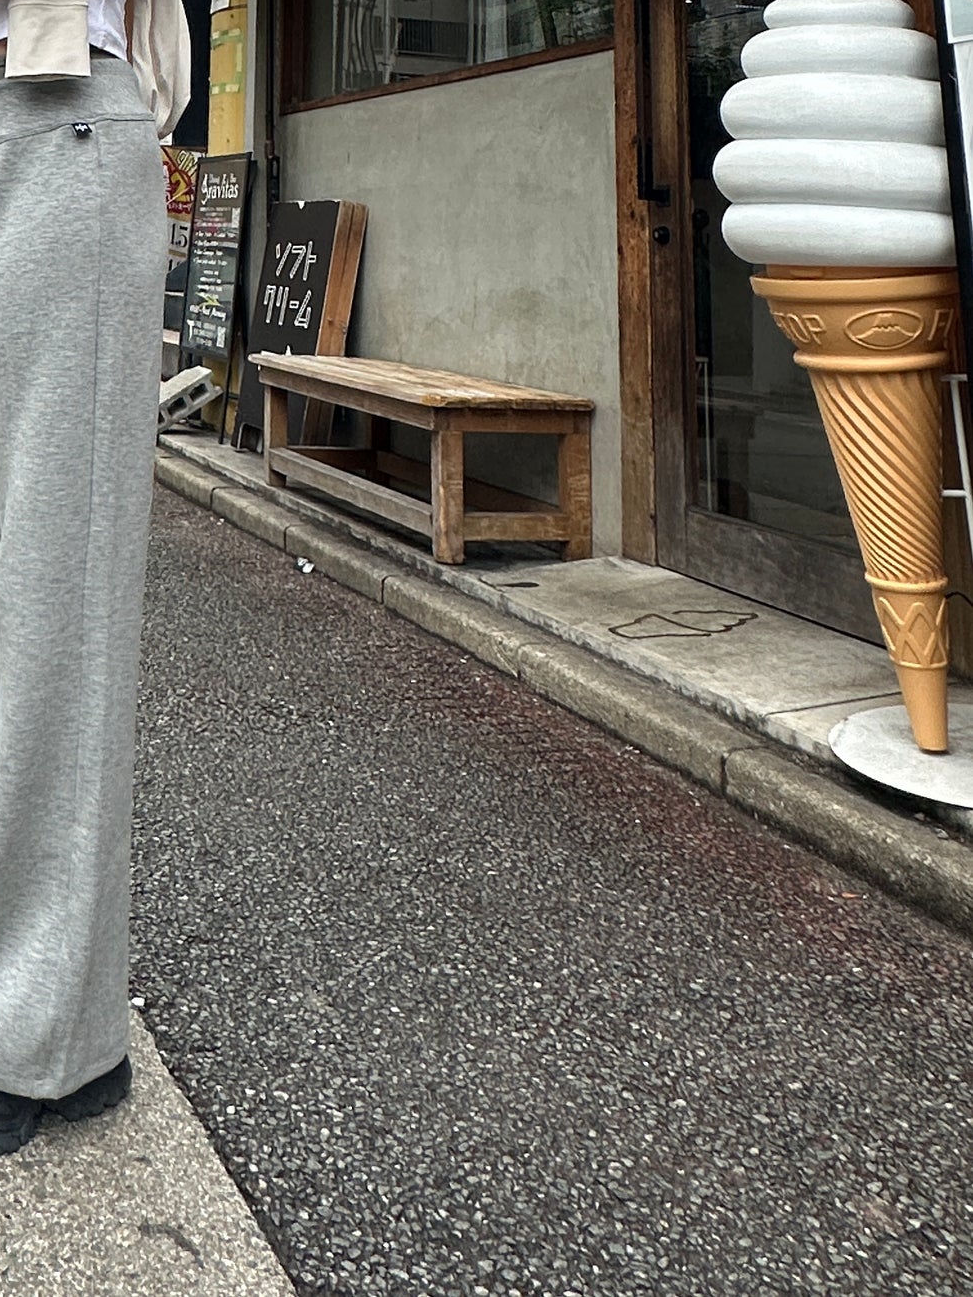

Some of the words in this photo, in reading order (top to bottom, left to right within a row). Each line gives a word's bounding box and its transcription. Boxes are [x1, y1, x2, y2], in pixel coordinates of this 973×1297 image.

[276, 240, 317, 281] ソフト
[263, 284, 313, 329] クリーム
